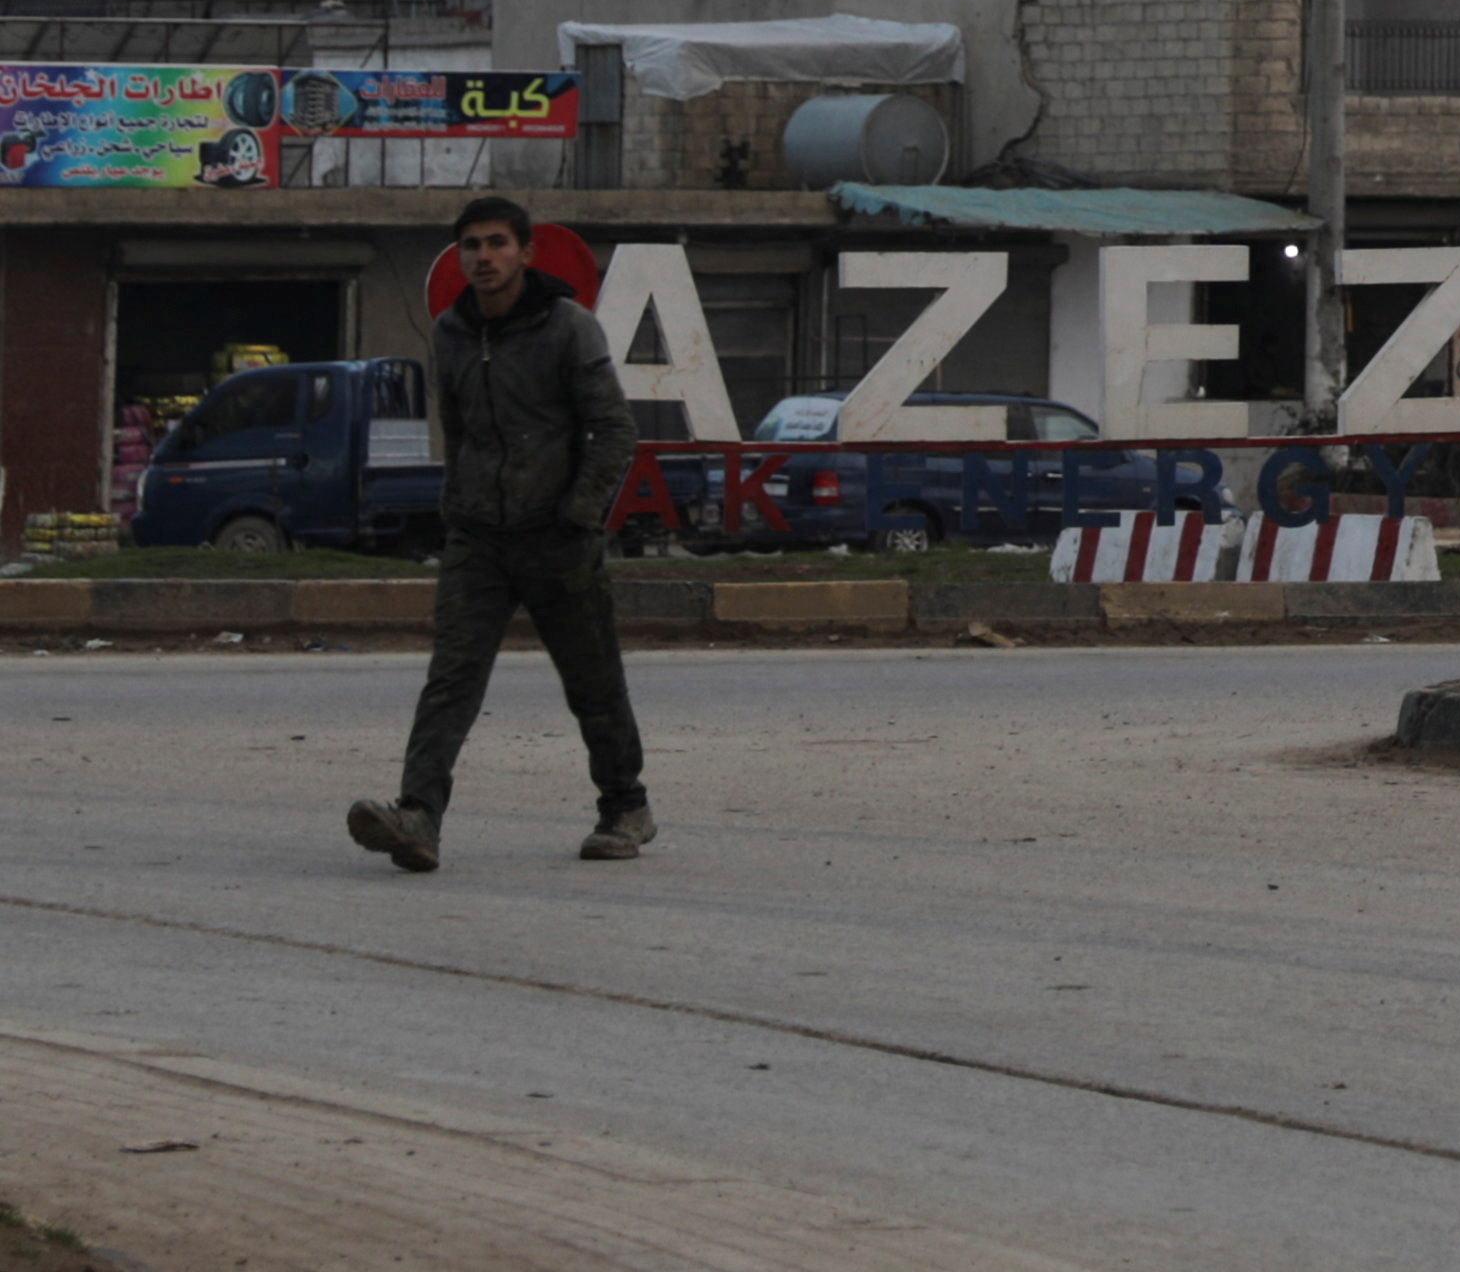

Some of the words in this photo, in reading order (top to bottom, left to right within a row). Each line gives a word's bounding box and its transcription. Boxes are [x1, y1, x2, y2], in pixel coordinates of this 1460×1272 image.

[123, 74, 223, 108] اطارات
[460, 76, 551, 129] كبة
[605, 444, 793, 533] AK
[866, 444, 1432, 530] ENERGY
